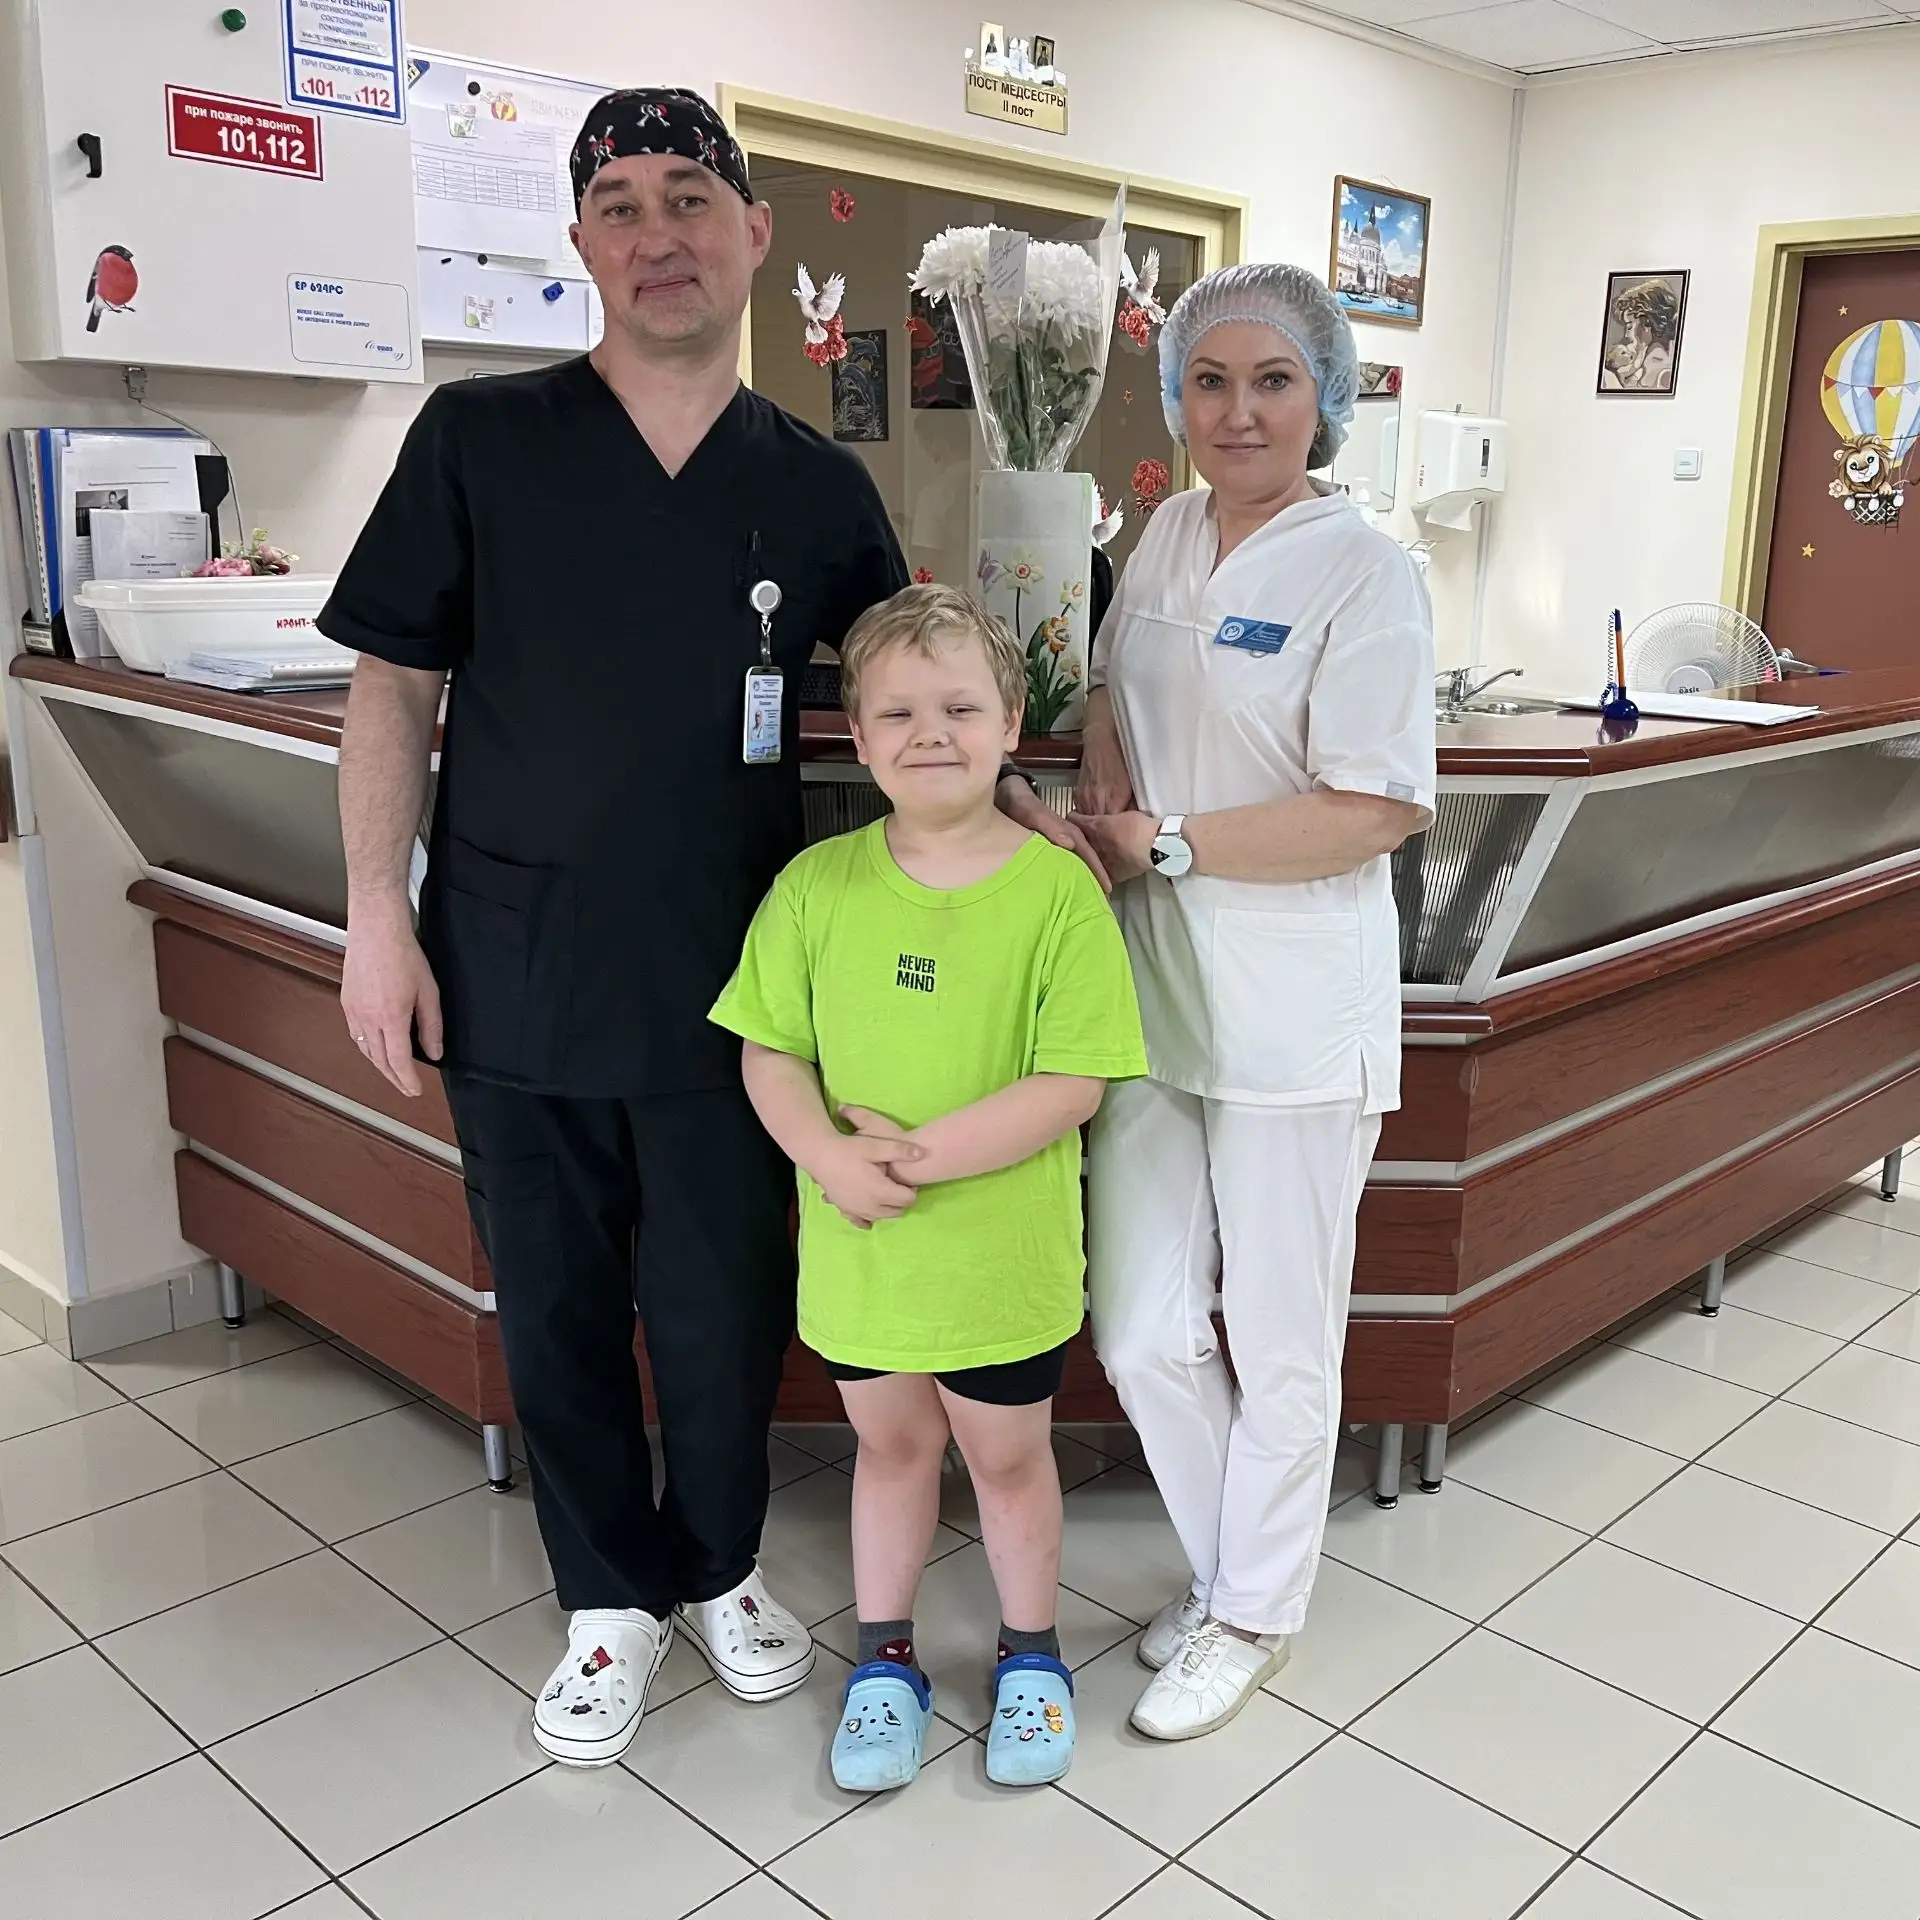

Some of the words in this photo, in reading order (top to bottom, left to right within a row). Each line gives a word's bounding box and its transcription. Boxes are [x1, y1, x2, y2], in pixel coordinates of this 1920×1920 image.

[321, 14, 364, 28] состояние
[301, 59, 318, 68] ПРИ
[320, 62, 351, 75] ПОЖАРЕ
[354, 67, 387, 80] ЗВОНИТЬ
[307, 77, 334, 98] 101
[361, 86, 390, 108] 112
[969, 74, 998, 91] ПОСТ
[1001, 82, 1066, 108] МЕДСЕСТРЫ
[185, 104, 208, 119] при
[211, 109, 254, 127] пожаре
[256, 117, 303, 134] звонить
[1003, 100, 1009, 112] II
[1012, 105, 1034, 118] пост
[217, 126, 306, 165] 101,112
[295, 281, 307, 291] EP
[310, 283, 344, 295] 624PC
[898, 953, 936, 974] NEVER
[896, 970, 935, 992] MIND
